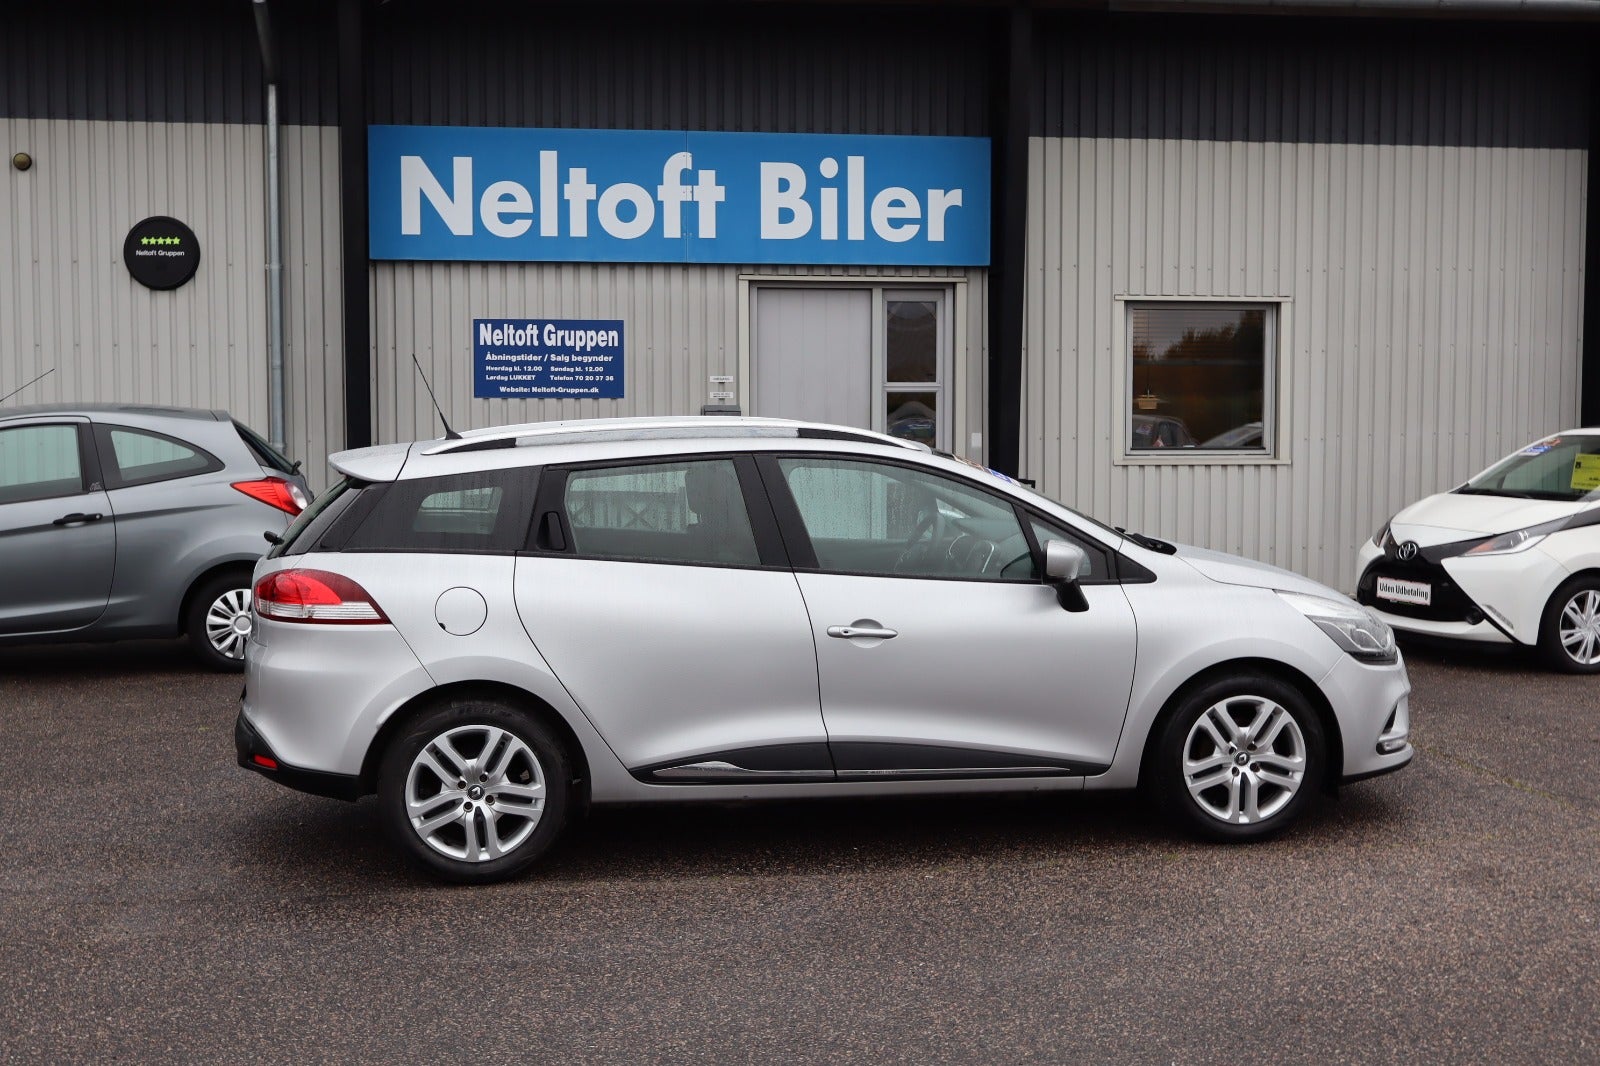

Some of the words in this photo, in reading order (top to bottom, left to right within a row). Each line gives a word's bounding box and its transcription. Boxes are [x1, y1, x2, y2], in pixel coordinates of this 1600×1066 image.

[400, 150, 726, 239] Neltoft
[760, 156, 963, 242] Biler
[479, 323, 539, 347] Neltoft
[543, 323, 619, 352] Gruppen
[485, 351, 542, 363] Åbningstider
[550, 354, 570, 362] Salg
[571, 354, 613, 363] begynder
[532, 386, 599, 394] Neltoft-Gruppen.dk
[1379, 582, 1395, 593] Uden
[1395, 583, 1429, 601] Udbetaling
